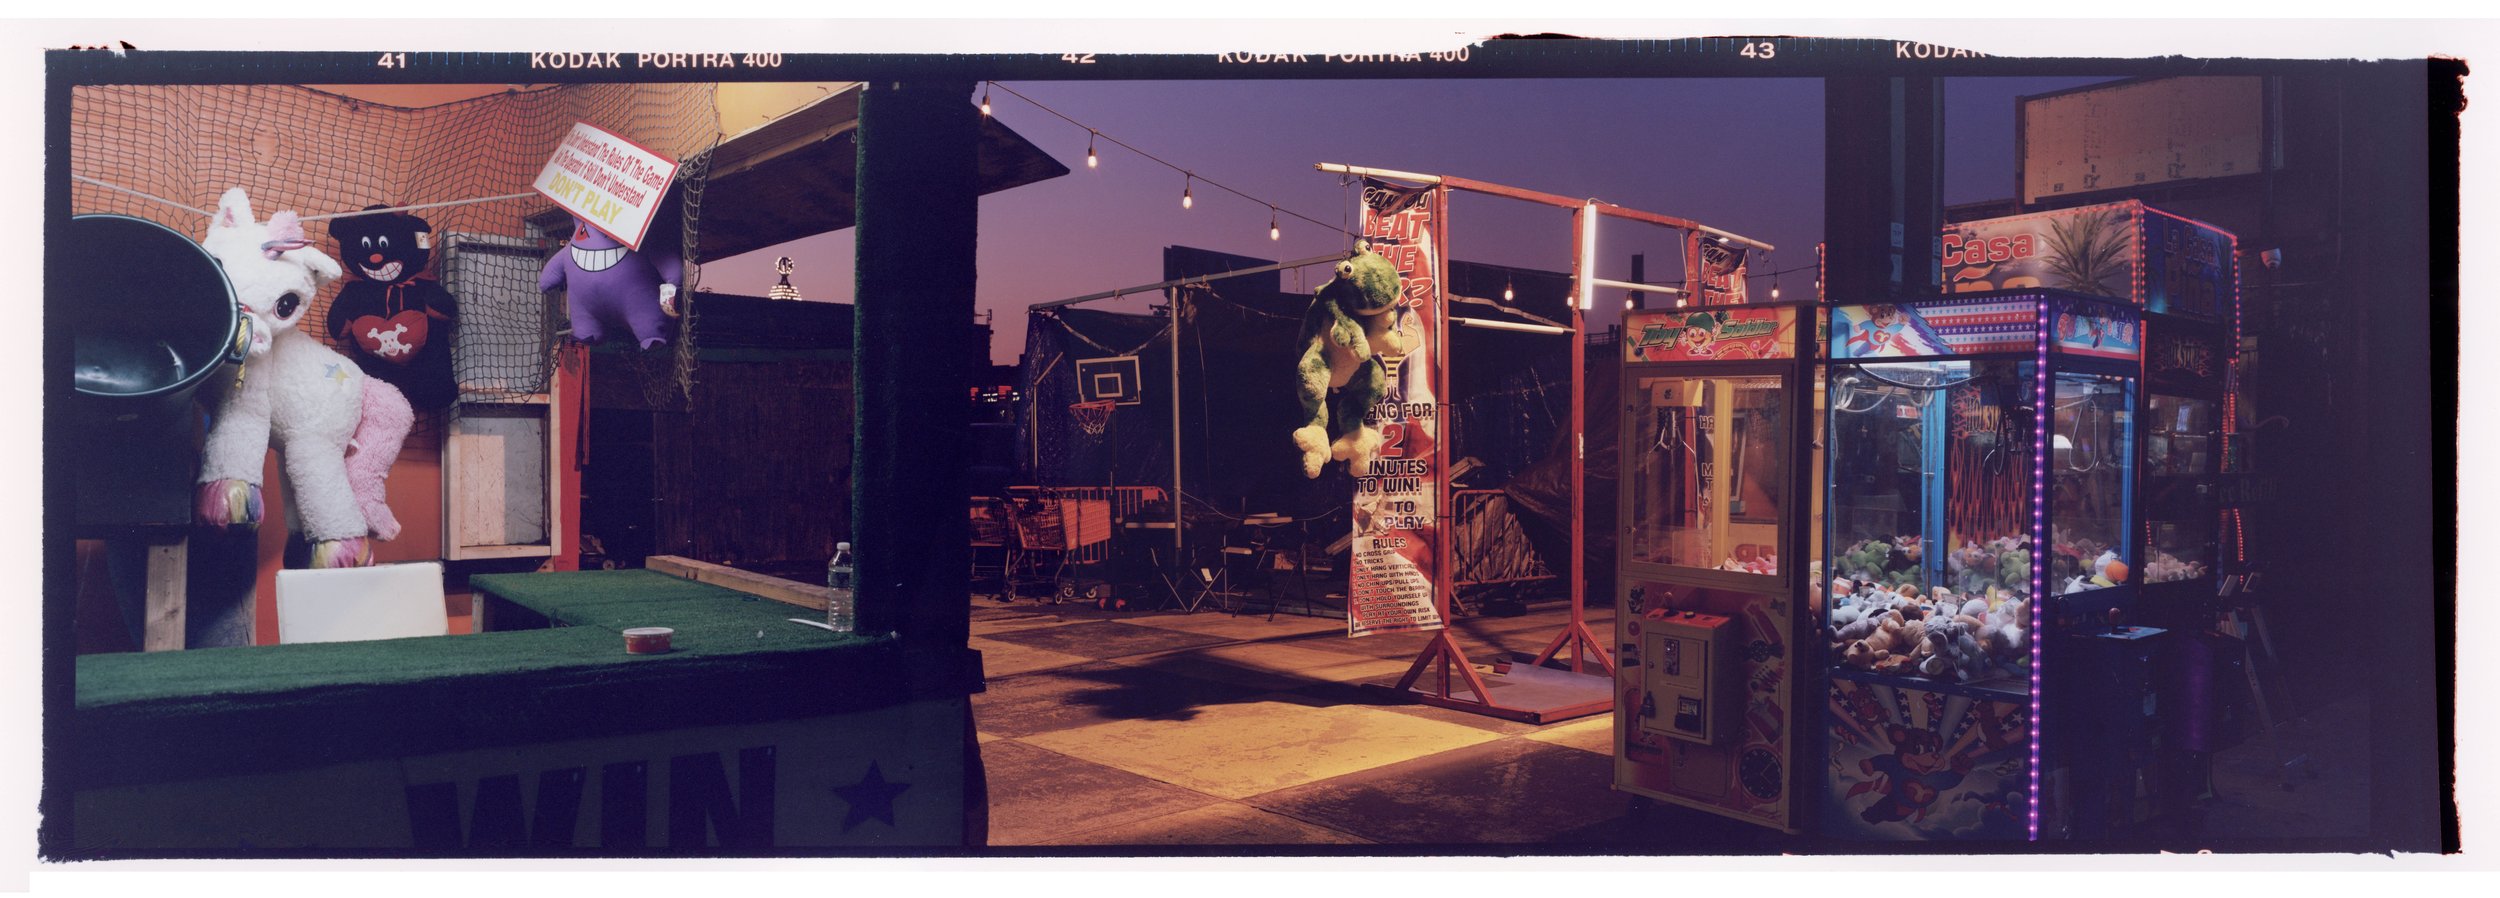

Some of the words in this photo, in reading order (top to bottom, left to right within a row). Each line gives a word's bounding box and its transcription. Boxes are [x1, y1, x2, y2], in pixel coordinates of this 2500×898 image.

[1061, 52, 1096, 64] 42
[1429, 45, 1470, 62] 400
[1739, 42, 1776, 59] 43
[377, 52, 406, 68] 41
[531, 52, 621, 69] KODAK
[638, 52, 735, 69] PORTRA
[742, 52, 783, 68] 400
[597, 142, 610, 163] The
[606, 146, 623, 170] Rules
[621, 154, 635, 174] Of
[629, 158, 645, 180] The
[642, 165, 665, 191] Game
[593, 167, 612, 190] Don't
[607, 174, 648, 208] Understand
[549, 171, 585, 204] DON'T
[583, 190, 623, 225] PLAY
[1363, 208, 1431, 240] BEAT
[1942, 233, 2036, 268] Casa
[2184, 225, 2218, 266] Casa
[1701, 261, 1747, 290] BEAT
[1638, 323, 1683, 350] Toy
[1712, 319, 1779, 342] Soldier
[1366, 403, 1398, 420] ANG
[1402, 402, 1433, 419] FOR
[1699, 415, 1714, 429] HA
[1380, 423, 1404, 457] 2
[1366, 459, 1427, 475] INUTES
[1359, 478, 1377, 493] TO
[1383, 477, 1420, 492] WIN!
[1395, 500, 1416, 513] TO
[1384, 516, 1425, 529] PLAY
[1373, 538, 1407, 550] RULES
[1375, 601, 1419, 609] SURROUNDINGS
[404, 744, 776, 848] WIN
